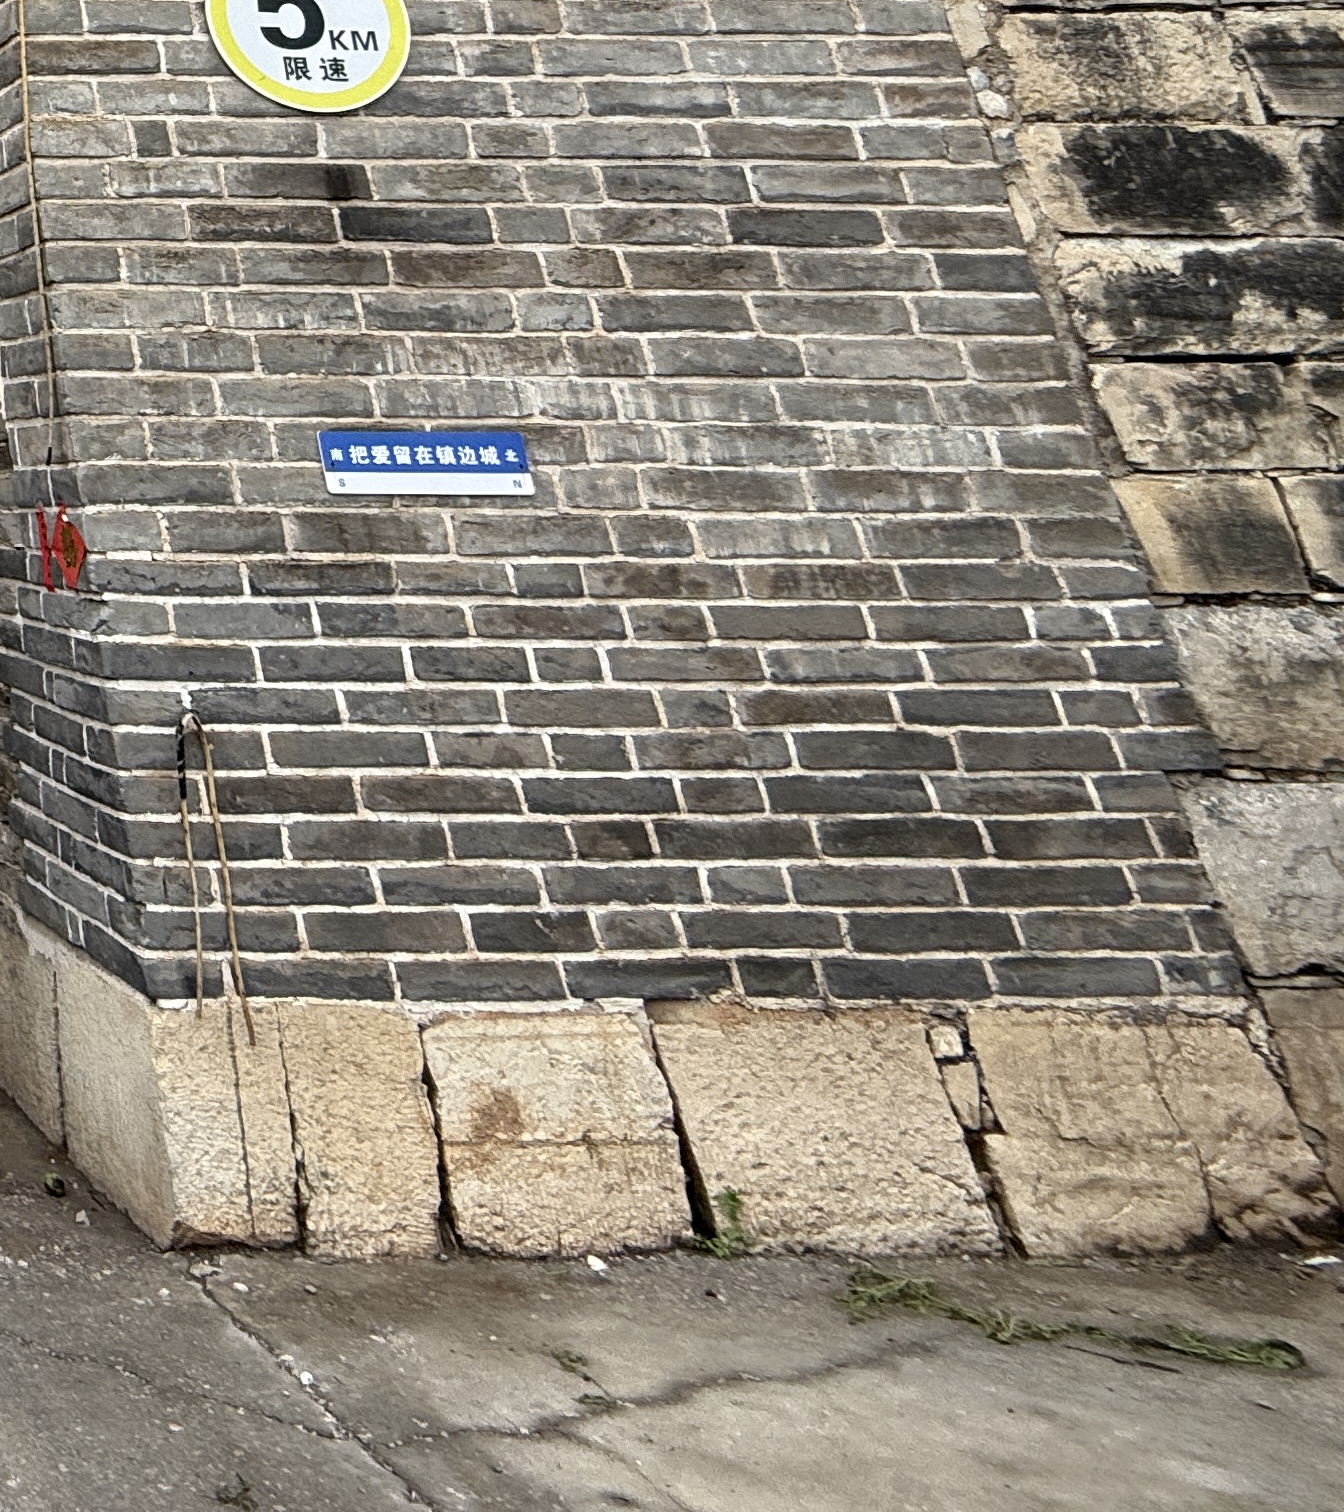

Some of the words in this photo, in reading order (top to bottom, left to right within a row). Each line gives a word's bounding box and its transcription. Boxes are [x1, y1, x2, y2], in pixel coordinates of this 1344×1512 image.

[328, 29, 379, 52] KM
[282, 56, 349, 83] 限速
[348, 444, 501, 466] 把爱留在镇边城
[504, 448, 519, 463] 北
[338, 478, 347, 488] S
[513, 479, 523, 489] N
